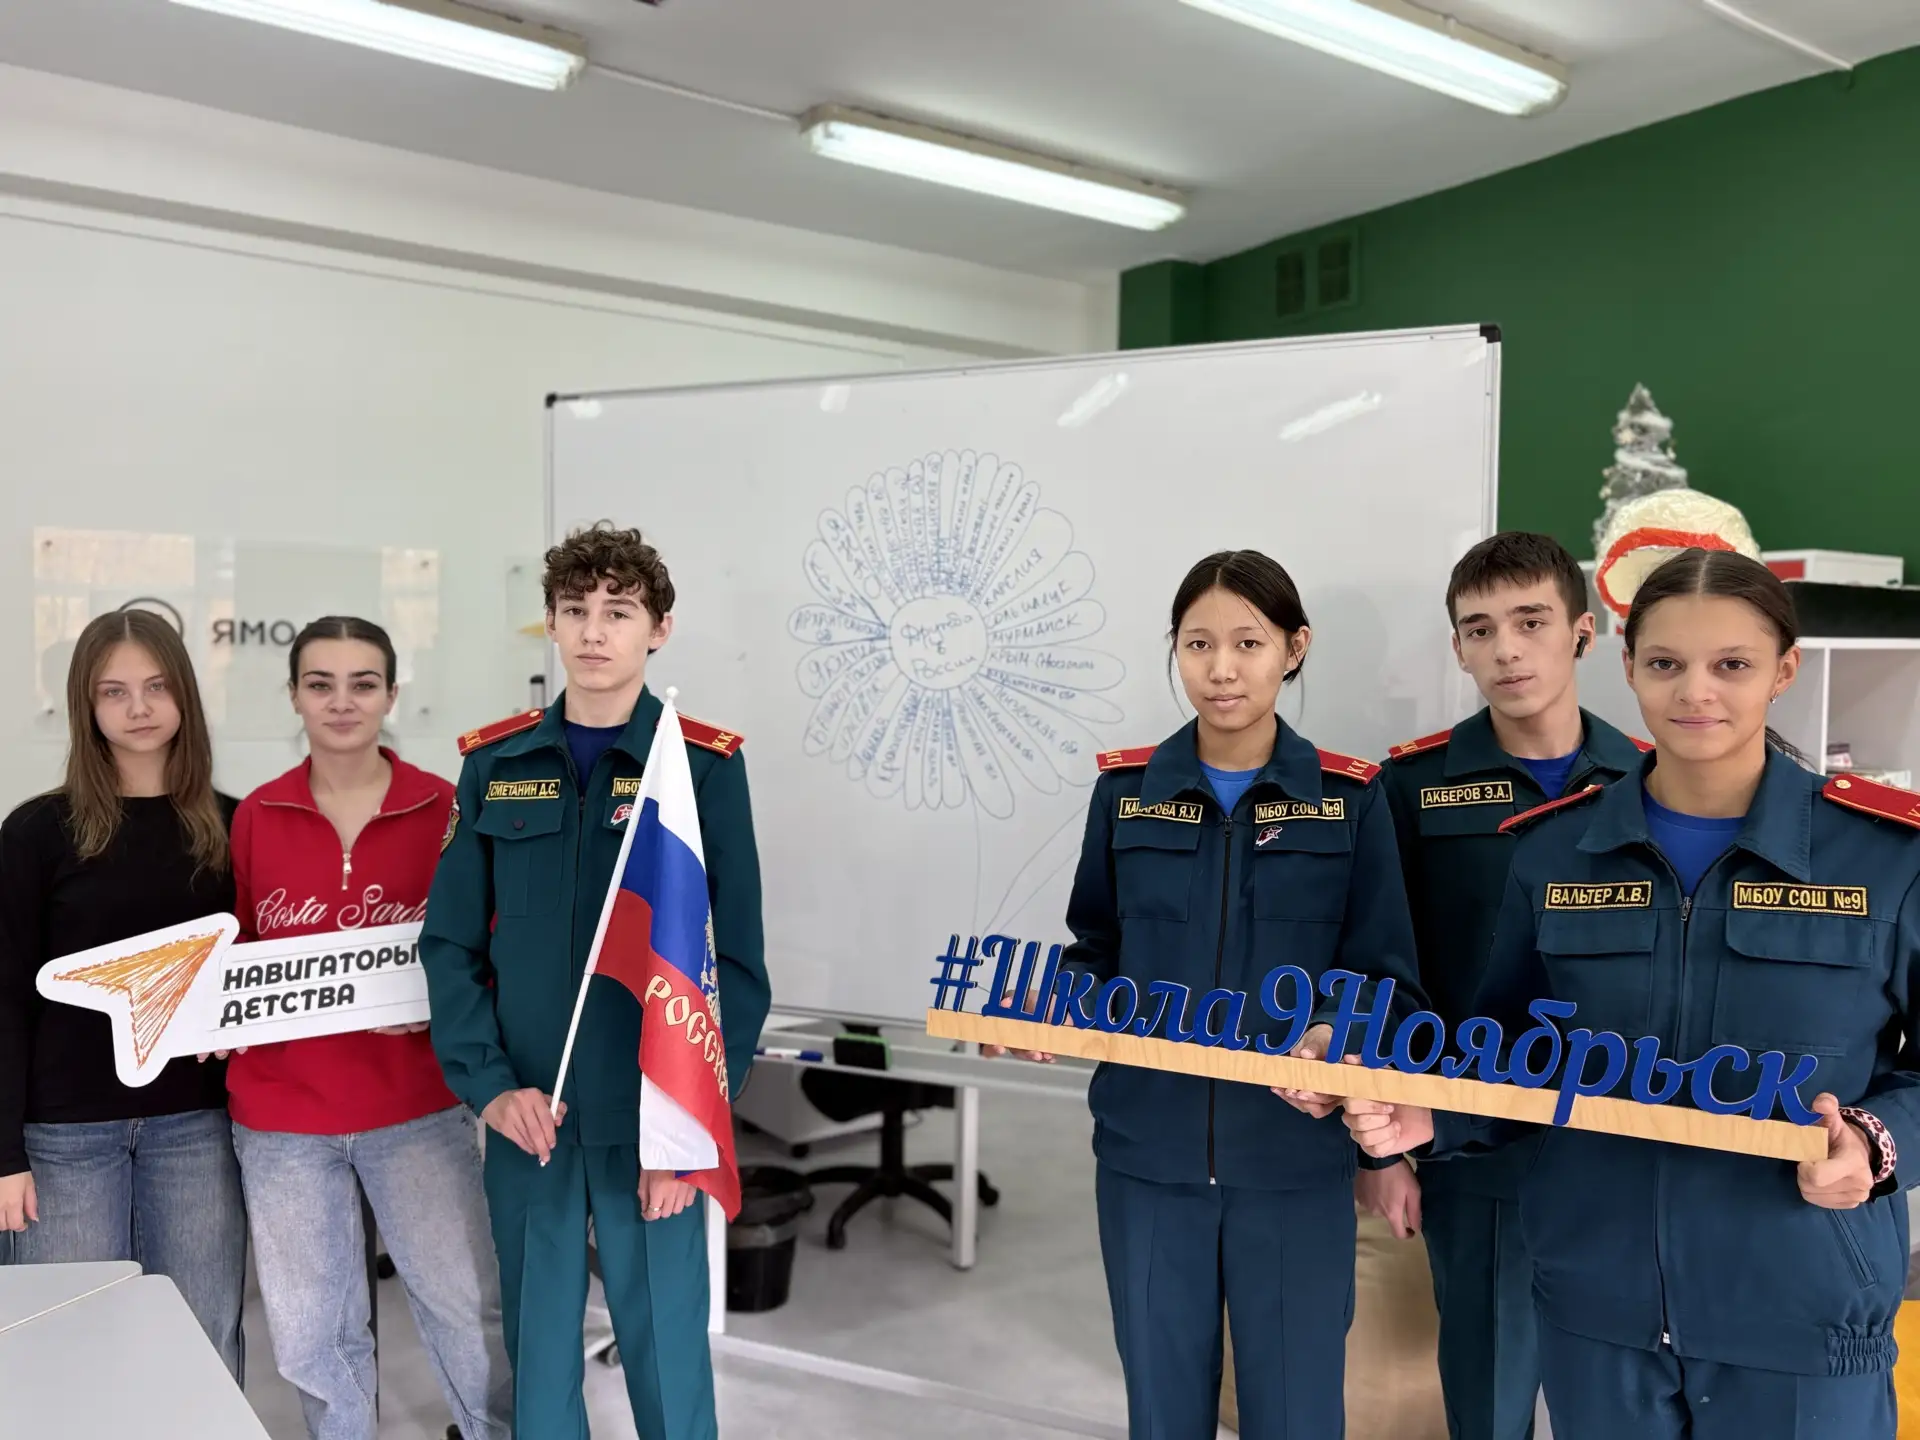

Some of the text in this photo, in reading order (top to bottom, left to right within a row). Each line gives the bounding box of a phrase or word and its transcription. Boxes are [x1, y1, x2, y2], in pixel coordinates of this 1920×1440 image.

[490, 781, 558, 798] СМЕТАНИН Д.С.
[1425, 785, 1510, 805] АКБЕРОВ Э.А.
[1258, 802, 1341, 819] МБОУ СОШ №9
[1551, 886, 1645, 905] ВАЛЬТЕР А.В.
[1739, 886, 1862, 910] МБОУ СОШ №9
[255, 888, 329, 935] Costa
[222, 942, 419, 992] НАВИГАТОРЫ
[219, 983, 356, 1028] ДЕТСТВА
[930, 931, 1825, 1126] #Школа9Ноябрьск
